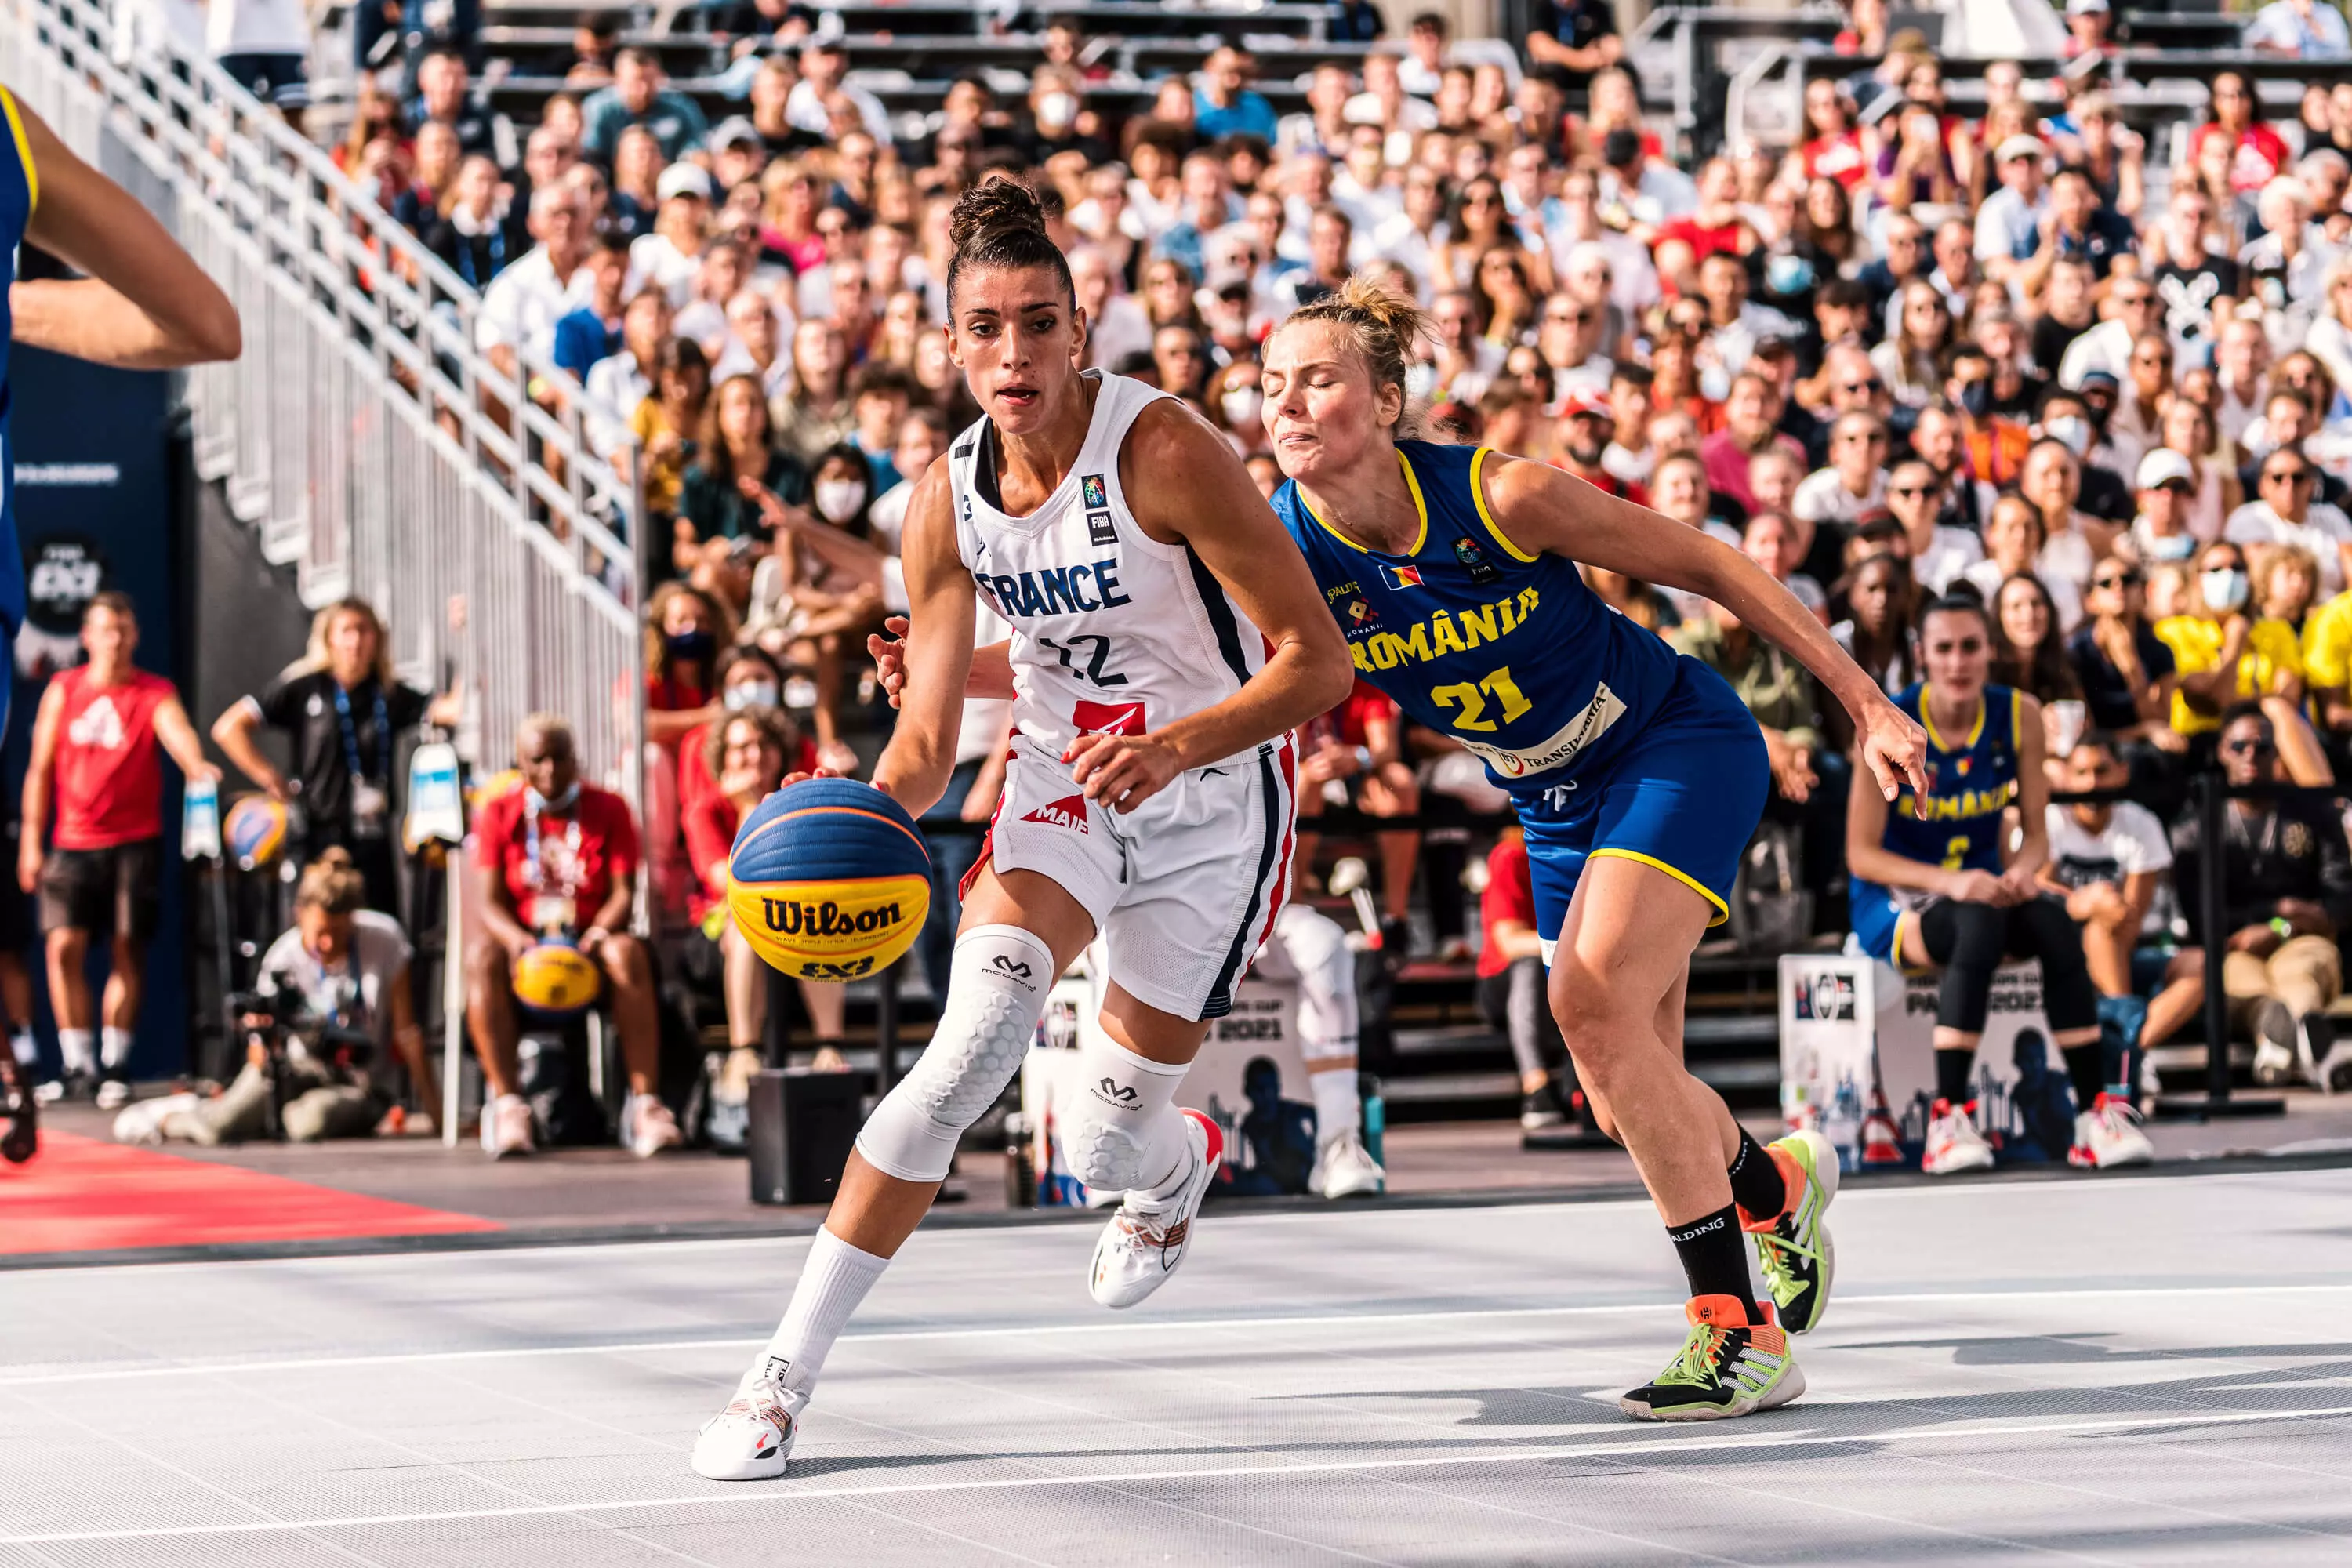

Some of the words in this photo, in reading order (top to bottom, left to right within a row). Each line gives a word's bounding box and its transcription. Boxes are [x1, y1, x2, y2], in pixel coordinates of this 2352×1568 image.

[1091, 515, 1109, 528] FIBA
[975, 557, 1134, 618] FRANCE
[1039, 635, 1129, 688] 12
[1430, 666, 1533, 732] 21
[1035, 804, 1089, 835] MAIF
[761, 895, 902, 936] Wilson
